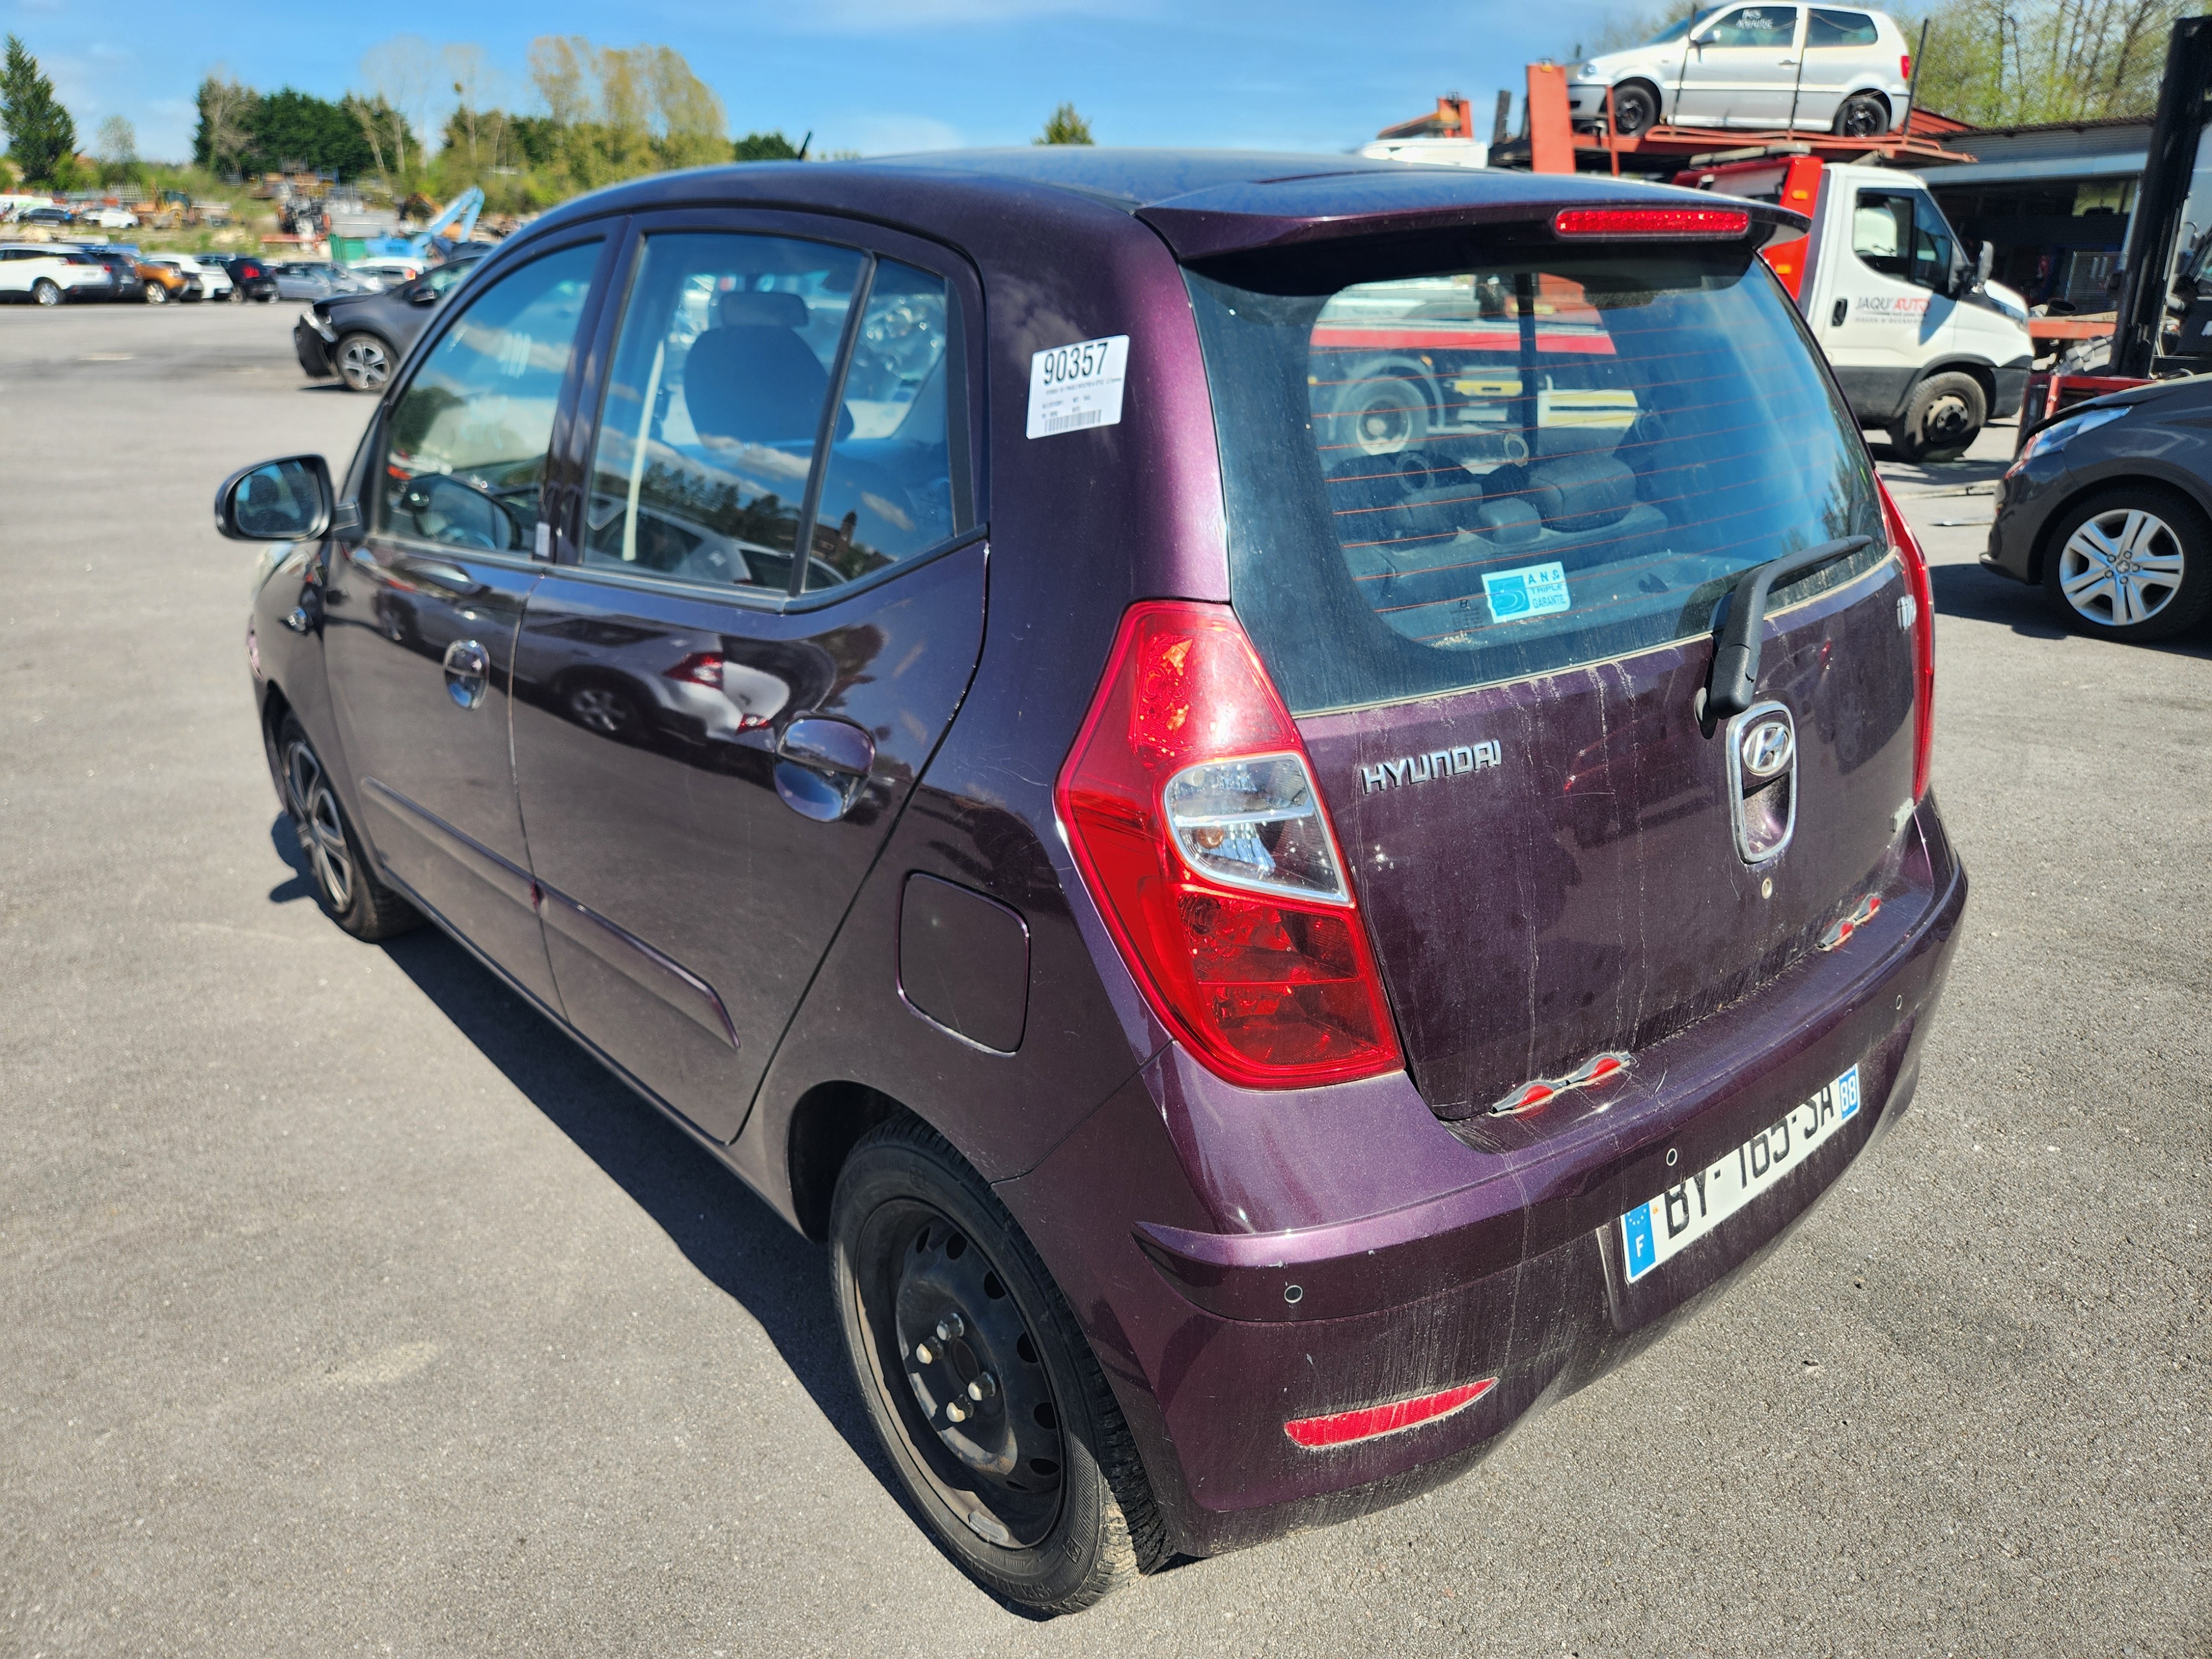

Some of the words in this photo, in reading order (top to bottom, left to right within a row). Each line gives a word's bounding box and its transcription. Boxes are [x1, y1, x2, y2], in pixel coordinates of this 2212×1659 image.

[1044, 341, 1108, 386] 90357
[1528, 570, 1560, 585] ANS
[1531, 583, 1562, 594] TRIPLE
[1361, 739, 1502, 794] HYUNDAI
[1635, 1234, 1644, 1258] F
[1840, 1074, 1857, 1113] 88
